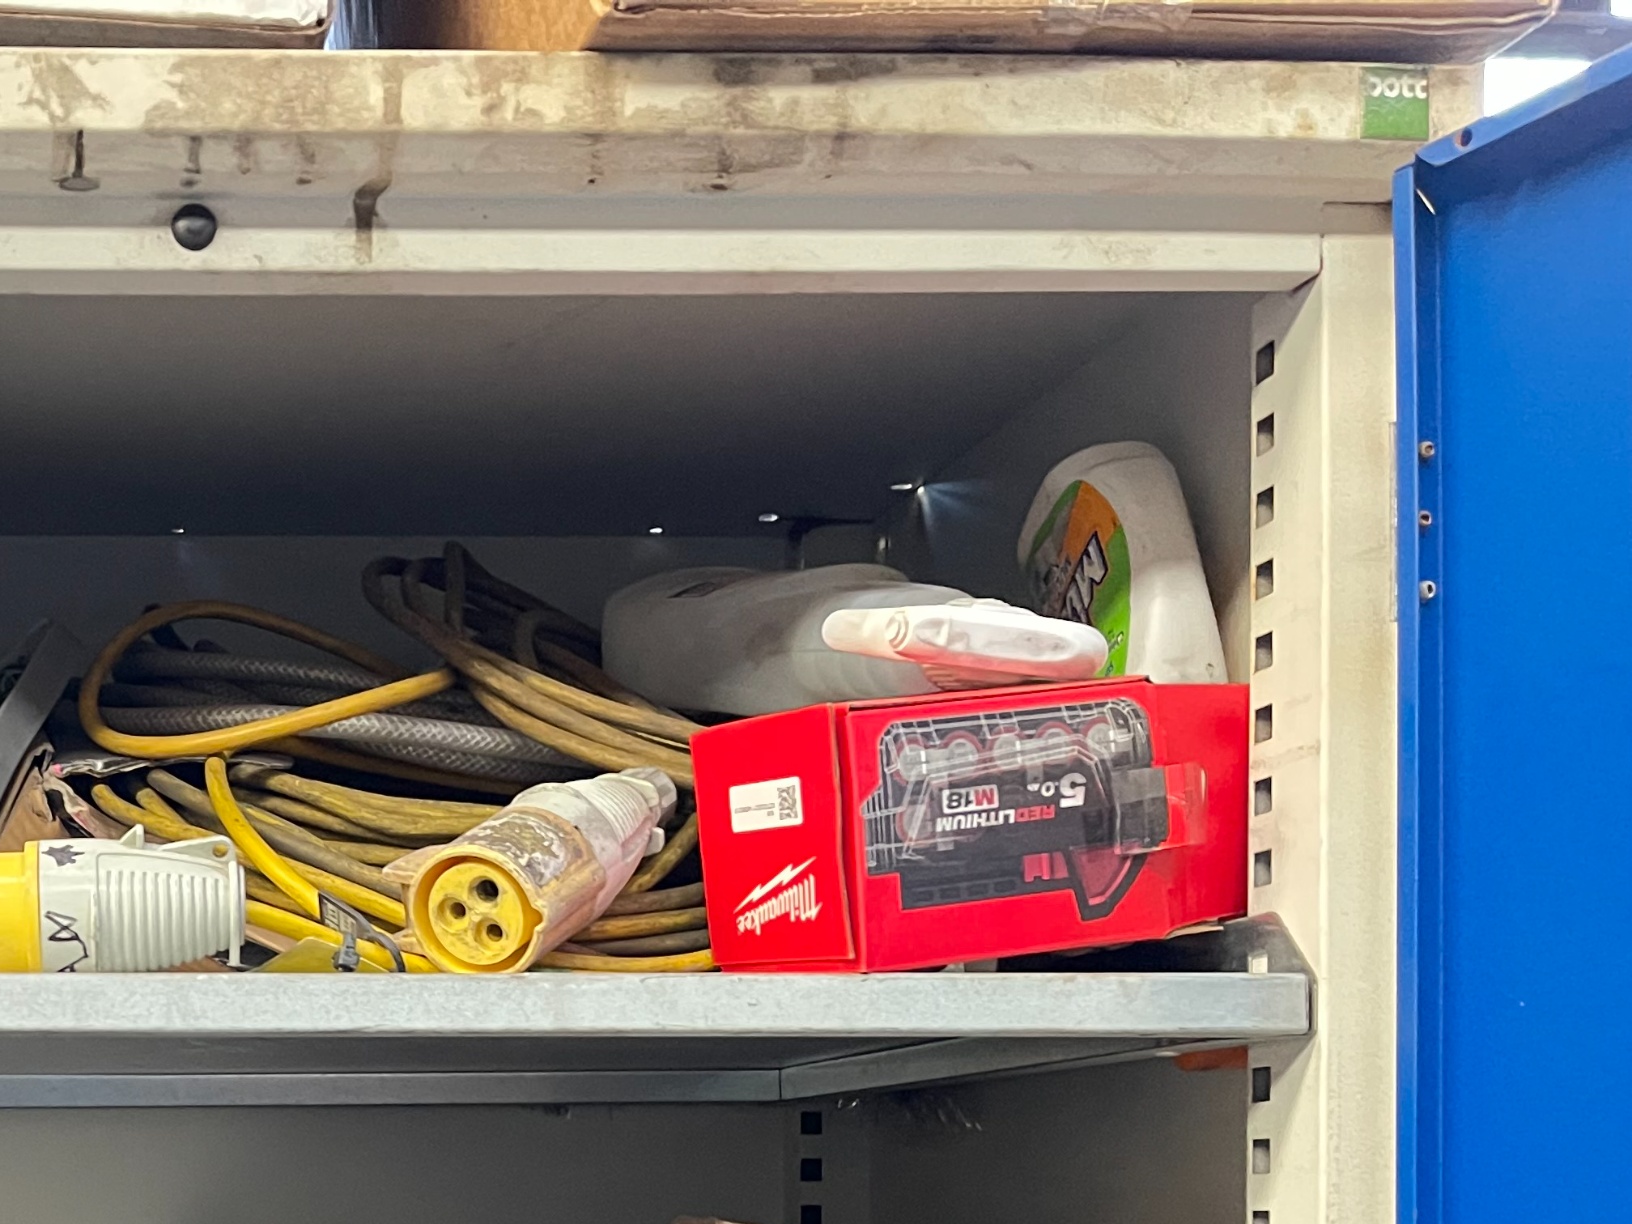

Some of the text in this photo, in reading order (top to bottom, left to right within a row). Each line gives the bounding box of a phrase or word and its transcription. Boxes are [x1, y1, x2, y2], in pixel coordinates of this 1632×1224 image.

[945, 787, 996, 811] M18
[934, 804, 1056, 833] REDLITHIUM
[735, 873, 822, 936] Milwaukee
